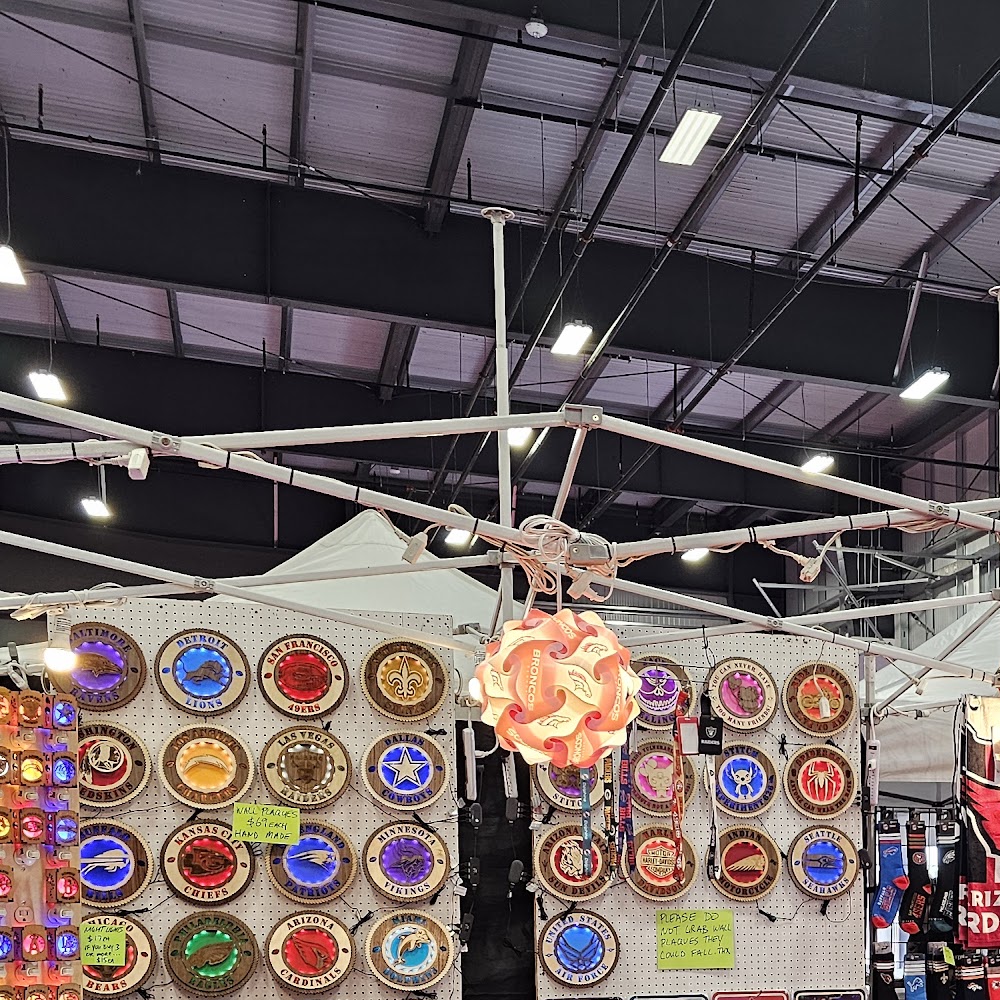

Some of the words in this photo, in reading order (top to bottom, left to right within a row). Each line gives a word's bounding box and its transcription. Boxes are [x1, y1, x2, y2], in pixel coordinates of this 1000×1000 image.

[70, 628, 132, 653] ALTIMORE
[176, 634, 229, 650] DETROIT
[266, 644, 284, 665] SAN
[285, 640, 339, 668] FRANCISCO
[720, 664, 731, 674] CAN
[734, 662, 756, 672] NEVER
[527, 649, 541, 711] BRONCOS
[185, 698, 223, 709] LIONS
[287, 703, 321, 713] 49ERS
[728, 716, 745, 726] MANY
[277, 732, 298, 747] LAS
[299, 731, 336, 750] VEGAS
[384, 734, 425, 746] DALLAS
[79, 781, 134, 801] EDSKINS
[280, 787, 333, 803] RAIDERS
[381, 787, 433, 804] COWBOYS
[246, 817, 267, 828] $69
[174, 826, 219, 847] KANSAS
[234, 830, 258, 839] HAND
[266, 831, 292, 840] MADE
[377, 825, 437, 846] MINNESOTA
[543, 826, 579, 855] ARIZONA
[727, 831, 762, 842] INDIAN
[803, 831, 843, 843] SEATTLE
[183, 885, 229, 900] CHIEFS
[285, 879, 342, 896] PATRIOTS
[384, 881, 432, 896] VIKINGS
[548, 876, 569, 893] SUN
[802, 878, 851, 894] SEAHAWKS
[286, 915, 335, 931] ARIZONA
[660, 912, 696, 924] PLEASE
[704, 912, 720, 921] DO
[545, 916, 574, 944] UNITED
[580, 915, 612, 940] STATES
[660, 926, 680, 936] NOT
[686, 924, 708, 934] GRAB
[713, 924, 732, 932] WALL
[660, 937, 698, 947] PLAQUES
[703, 935, 724, 946] THEY
[660, 950, 686, 959] COULD
[280, 967, 342, 987] CARDINALS
[555, 966, 574, 983] AIR
[578, 963, 609, 983] FORCE
[85, 979, 128, 992] BEARS
